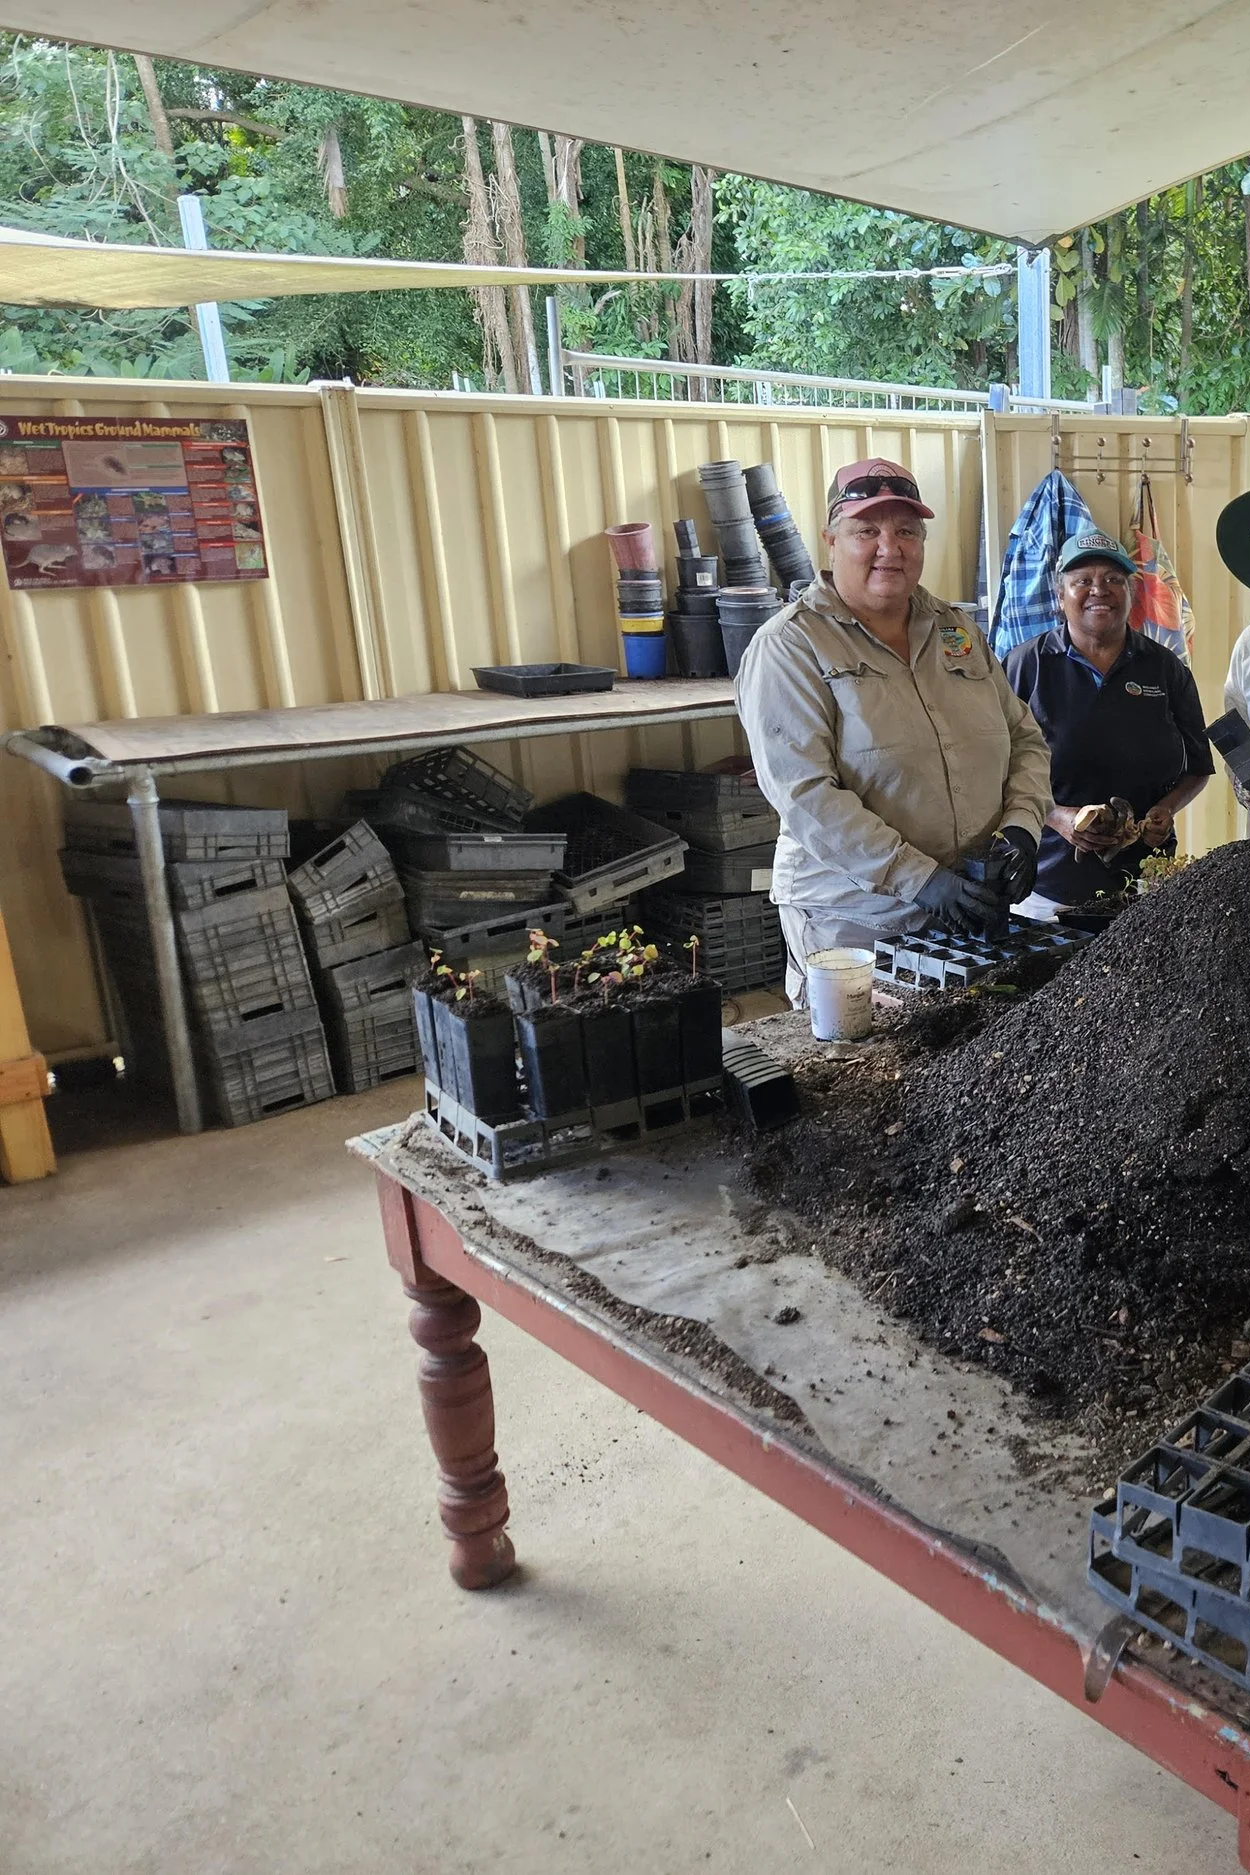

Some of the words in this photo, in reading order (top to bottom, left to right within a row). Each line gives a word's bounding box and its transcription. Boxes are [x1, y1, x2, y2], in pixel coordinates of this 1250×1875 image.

[18, 421, 46, 436] Wet
[46, 421, 94, 439] Tropics
[95, 421, 142, 438] Ground
[143, 422, 201, 437] Mammals
